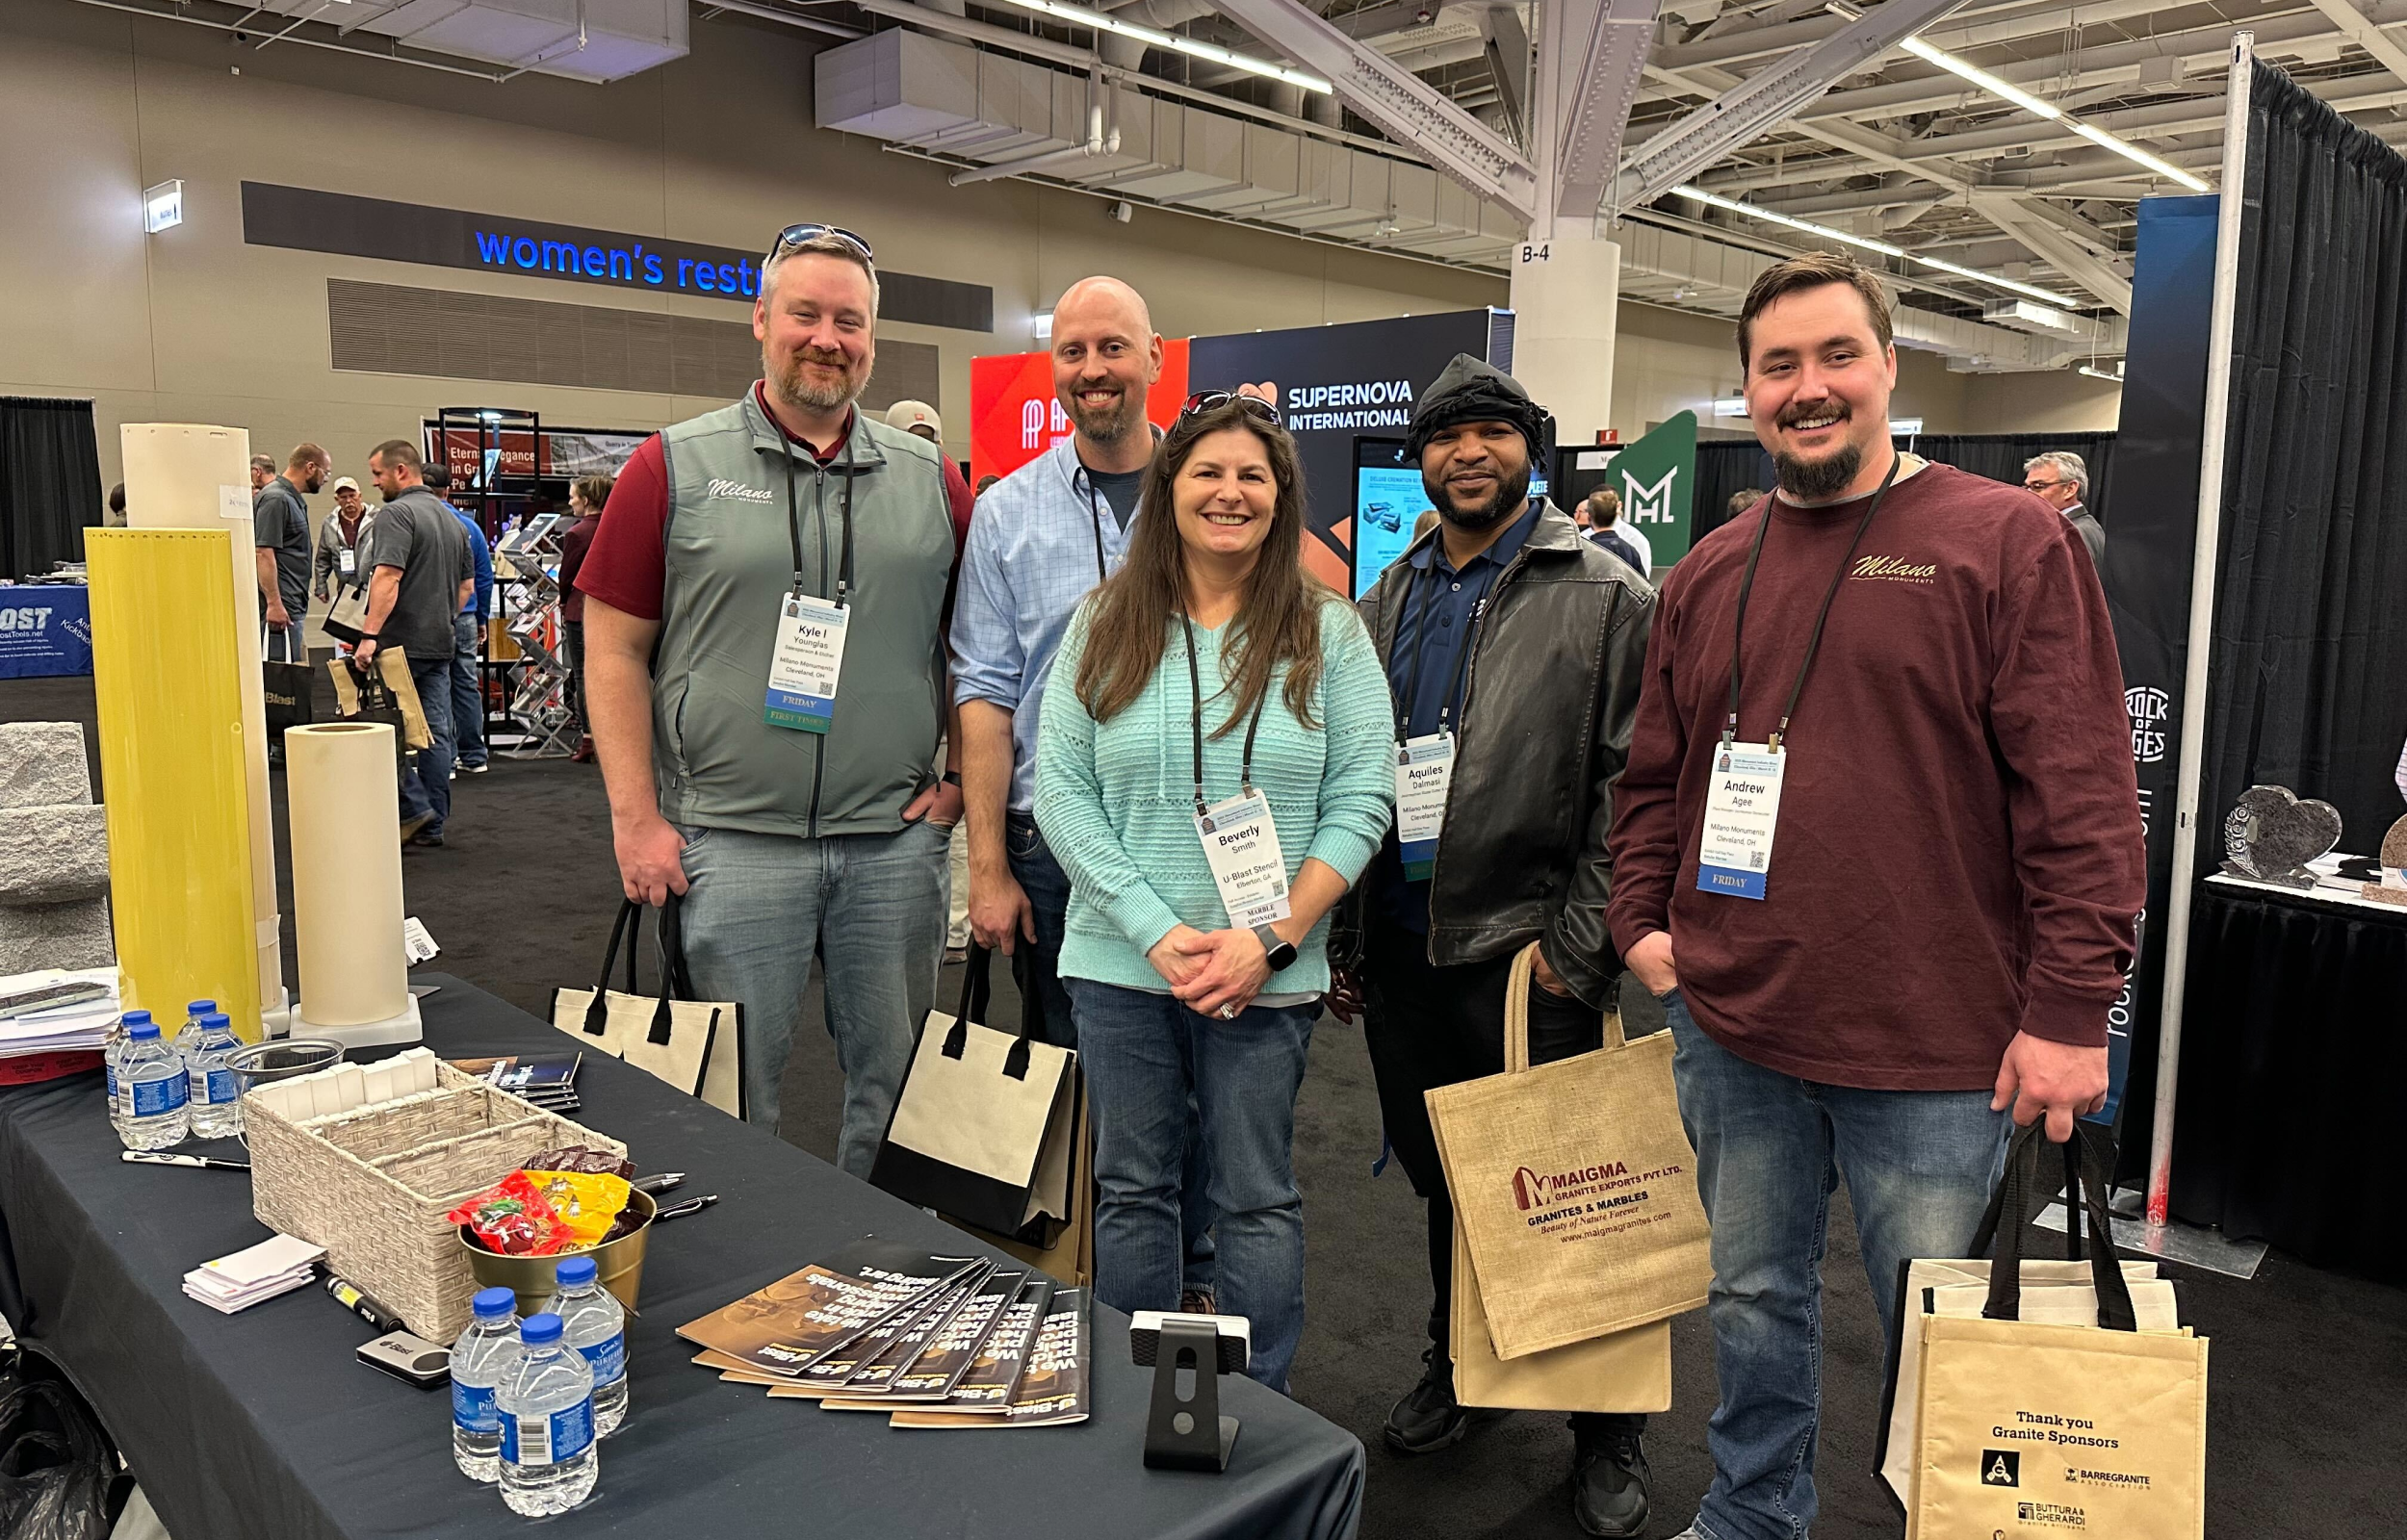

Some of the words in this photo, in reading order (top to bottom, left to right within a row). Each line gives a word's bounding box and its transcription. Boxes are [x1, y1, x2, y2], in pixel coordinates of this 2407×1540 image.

[476, 231, 664, 284] women's
[1522, 244, 1549, 263] B-4
[1288, 380, 1413, 409] SUPERNOVA
[1289, 408, 1411, 431] INTERNATIONAL
[451, 463, 461, 475] in
[708, 478, 773, 500] Milano
[1851, 555, 1937, 577] Milano
[798, 625, 821, 638] Kyle
[793, 635, 829, 650] Younglas
[779, 656, 799, 666] Milano
[799, 660, 835, 673] Monuments
[782, 694, 817, 708] FRIDAY
[2125, 692, 2168, 721] ROCK
[2135, 718, 2153, 730] OF
[2131, 729, 2165, 757] GES
[1408, 765, 1443, 781] Aquiles
[1412, 777, 1440, 789] Dalmasi
[1723, 780, 1765, 794] Andrew
[1422, 802, 1445, 810] Monume
[1731, 796, 1752, 808] Agee
[1218, 825, 1260, 846] Beverly
[1710, 823, 1730, 833] Milano
[1730, 826, 1766, 836] Monuments
[1231, 840, 1256, 855] Smith
[1716, 834, 1746, 846] Cleveland,
[1223, 868, 1253, 884] U-Blast
[1253, 859, 1279, 874] Stencil
[1236, 877, 1262, 889] Elberton,
[1712, 874, 1747, 888] FRIDAY
[1247, 904, 1276, 917] MARBLE
[1247, 911, 1278, 926] SPONSOR
[1551, 1161, 1628, 1191] MAIGMA
[1555, 1185, 1597, 1202] GRANITE
[1598, 1175, 1642, 1193] EXPORTS
[1643, 1169, 1661, 1182] PVT
[1662, 1165, 1683, 1177] LTD.
[1527, 1203, 1583, 1227] GRANITES
[1586, 1203, 1594, 1213] &
[1596, 1191, 1649, 1211] MARBLES
[1540, 1221, 1567, 1236] Beauty
[1569, 1219, 1580, 1229] of
[1579, 1213, 1608, 1227] Nature
[1609, 1206, 1640, 1219] Forever
[804, 1310, 843, 1326] take
[984, 1348, 1020, 1360] We
[1040, 1356, 1077, 1373] We
[2016, 1411, 2064, 1426] Thank
[2066, 1418, 2094, 1429] you
[1992, 1426, 2045, 1441] Granite
[2048, 1430, 2119, 1449] Sponsors
[2080, 1478, 2151, 1491] ASSOCIATION
[2081, 1470, 2151, 1485] BARREGRANITE
[2035, 1502, 2079, 1516] BUTTURA
[2035, 1512, 2085, 1526] GHERARDI
